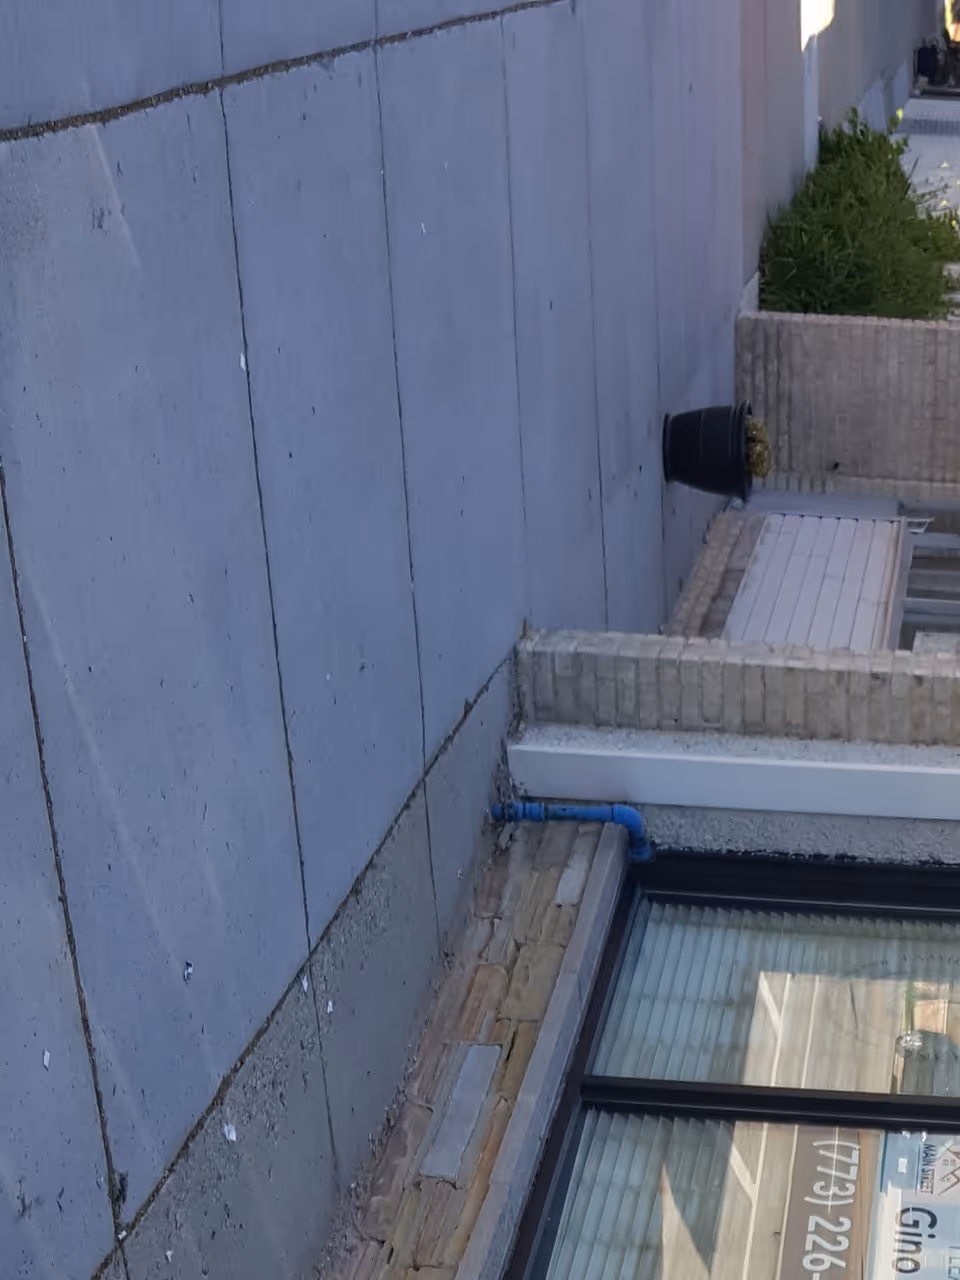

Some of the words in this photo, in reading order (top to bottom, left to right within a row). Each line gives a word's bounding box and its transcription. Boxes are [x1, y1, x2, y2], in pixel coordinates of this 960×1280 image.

[804, 1140, 860, 1206] (773)
[920, 1143, 936, 1167] MAIN
[920, 1168, 934, 1195] STREET
[890, 1207, 938, 1274] Gino
